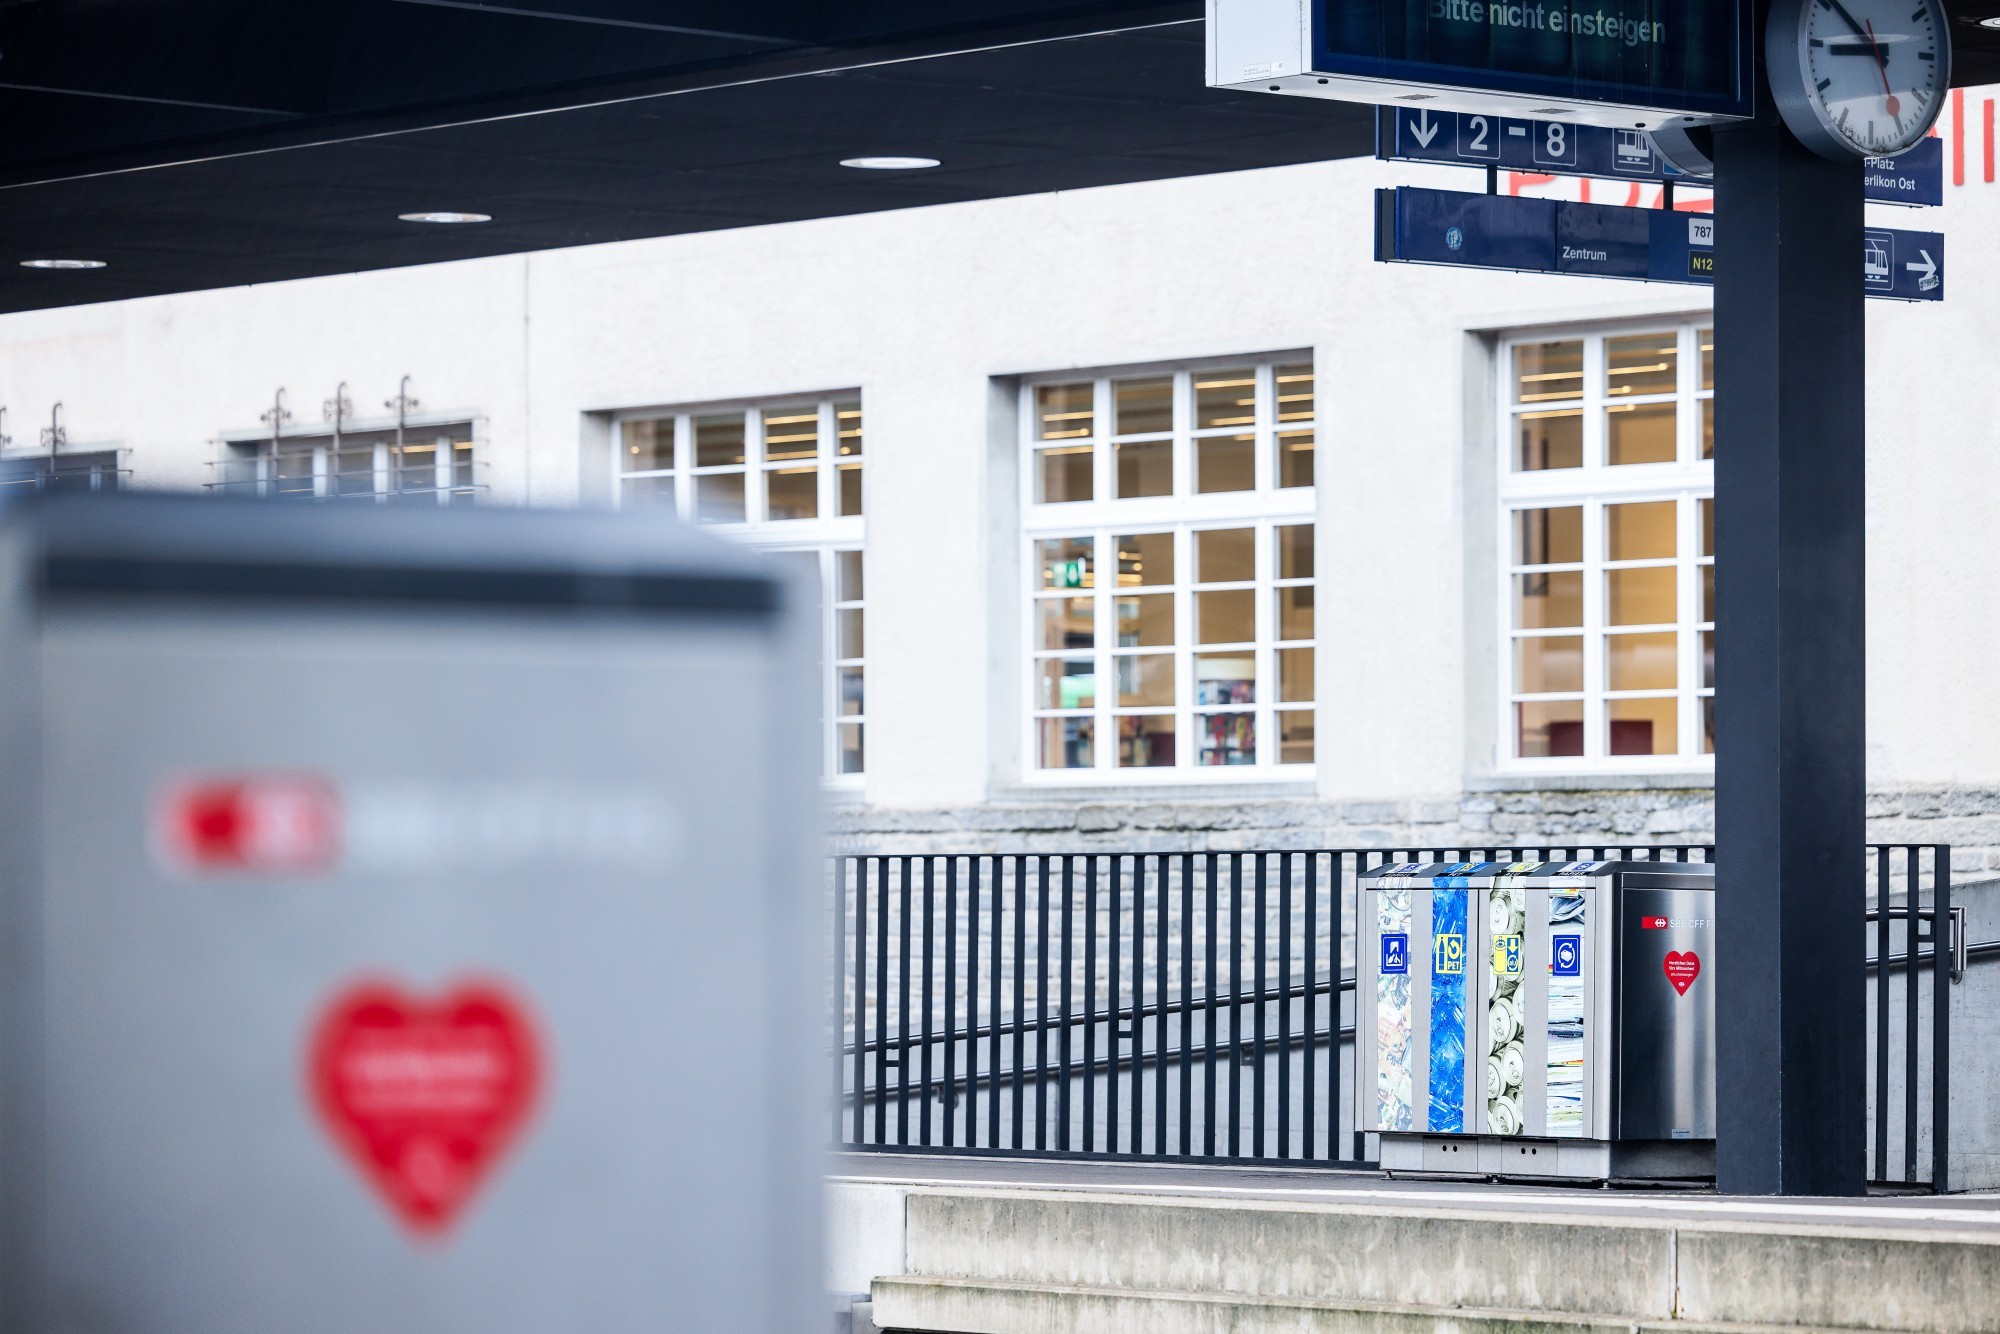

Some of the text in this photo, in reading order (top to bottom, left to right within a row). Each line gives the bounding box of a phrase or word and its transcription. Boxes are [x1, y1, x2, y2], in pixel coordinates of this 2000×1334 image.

[1428, 0, 1666, 46] Bitte nicht einsteigen
[1469, 116, 1488, 151] 2
[1546, 123, 1566, 157] 8
[1898, 177, 1916, 190] Ost
[1694, 226, 1712, 238] 787
[1563, 246, 1607, 261] Zentrum
[1670, 919, 1686, 928] SBB
[1689, 919, 1704, 929] CFF
[1447, 961, 1460, 970] PET
